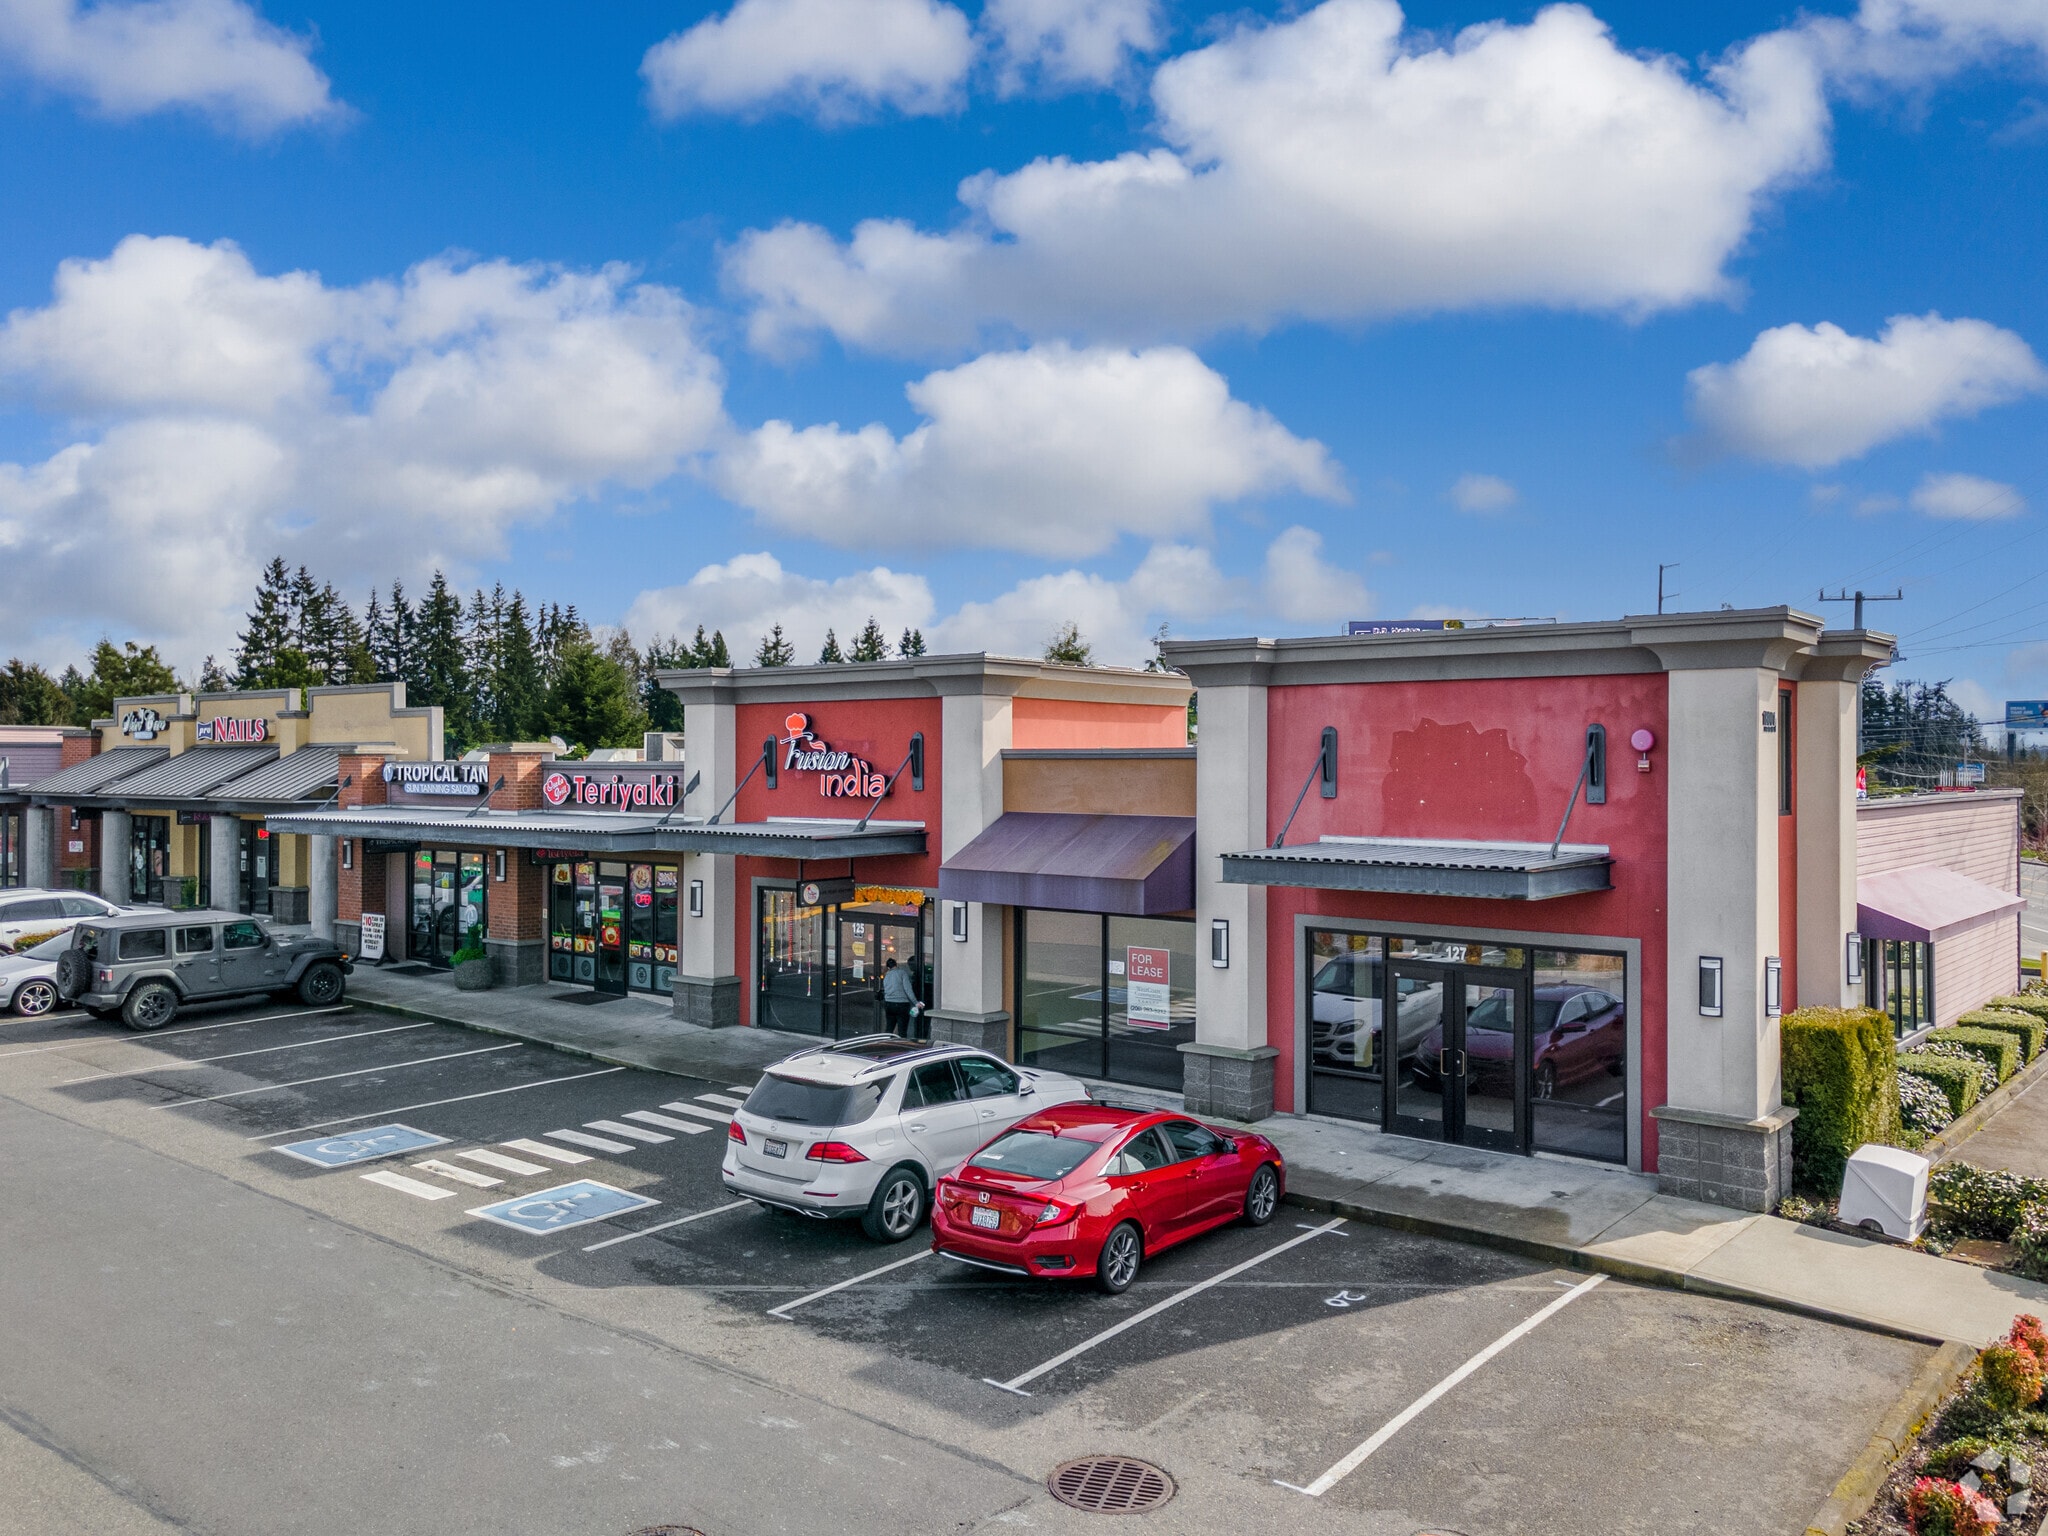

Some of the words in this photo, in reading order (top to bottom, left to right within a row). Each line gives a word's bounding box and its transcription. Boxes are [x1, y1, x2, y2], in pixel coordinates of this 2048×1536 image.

[214, 716, 266, 742] NAILS
[780, 731, 850, 771] Fusion
[396, 764, 458, 782] TROPICAL
[460, 764, 488, 783] TAN
[406, 783, 420, 793] SUN
[420, 784, 450, 794] TANNING
[450, 784, 479, 794] SALONS
[574, 774, 674, 812] Teriyaki
[852, 923, 864, 934] 125
[1132, 954, 1152, 964] FOR
[1446, 946, 1466, 960] 127
[1132, 966, 1164, 978] LEASE
